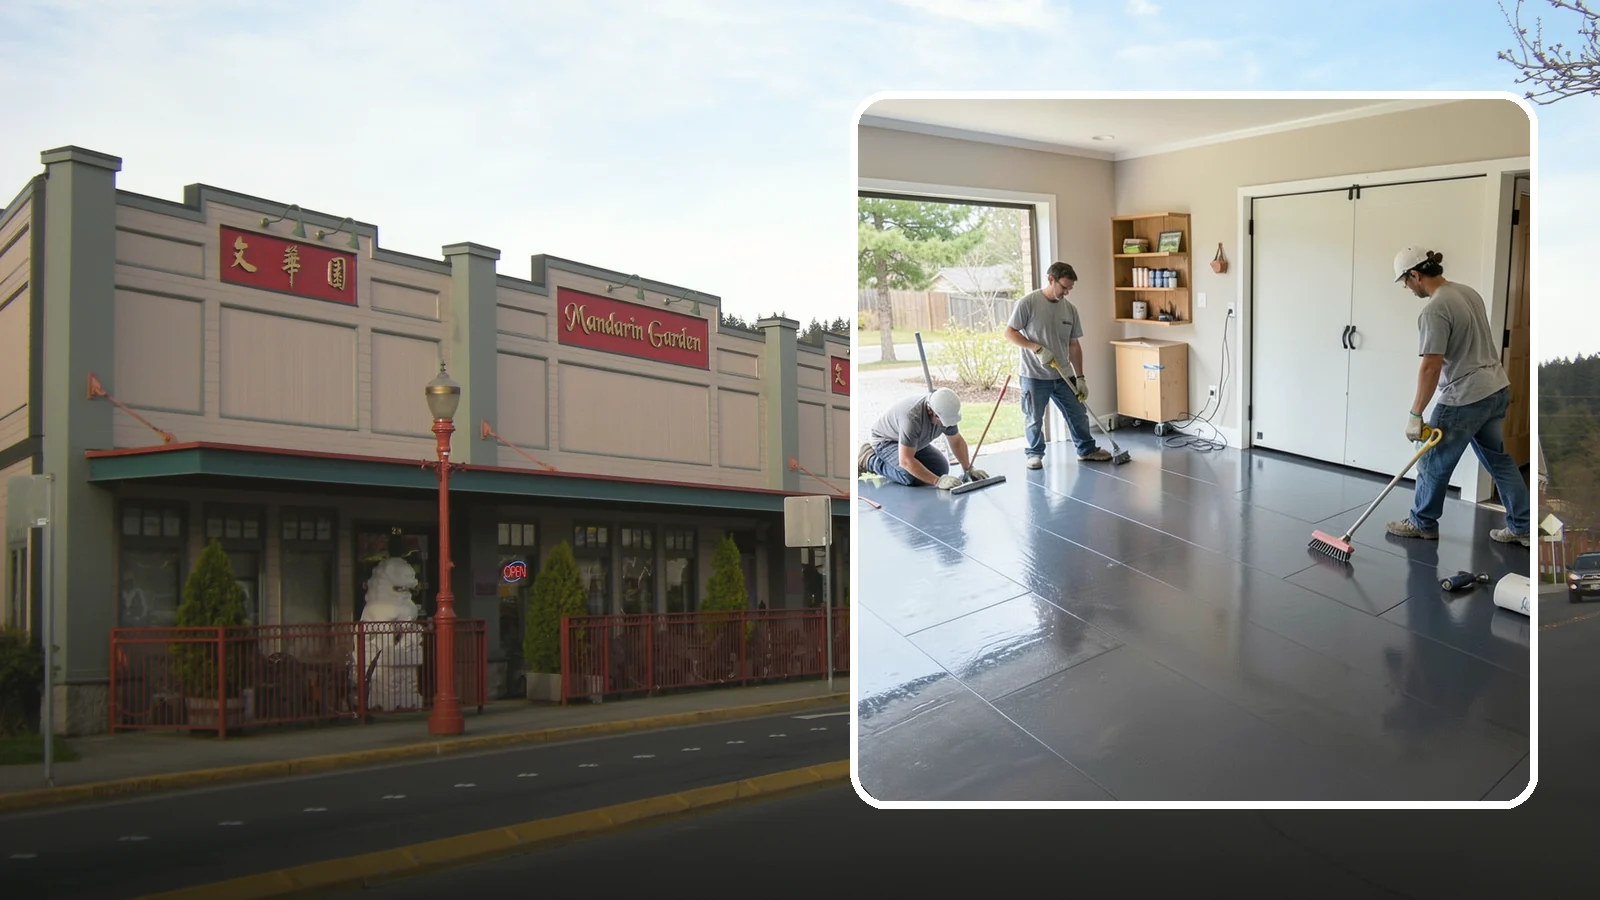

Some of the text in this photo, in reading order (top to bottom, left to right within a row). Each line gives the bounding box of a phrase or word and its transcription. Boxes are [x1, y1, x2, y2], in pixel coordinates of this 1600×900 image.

[231, 235, 346, 291] 文華園
[564, 302, 702, 352] Mandarin Garden
[503, 565, 527, 578] OPEN
